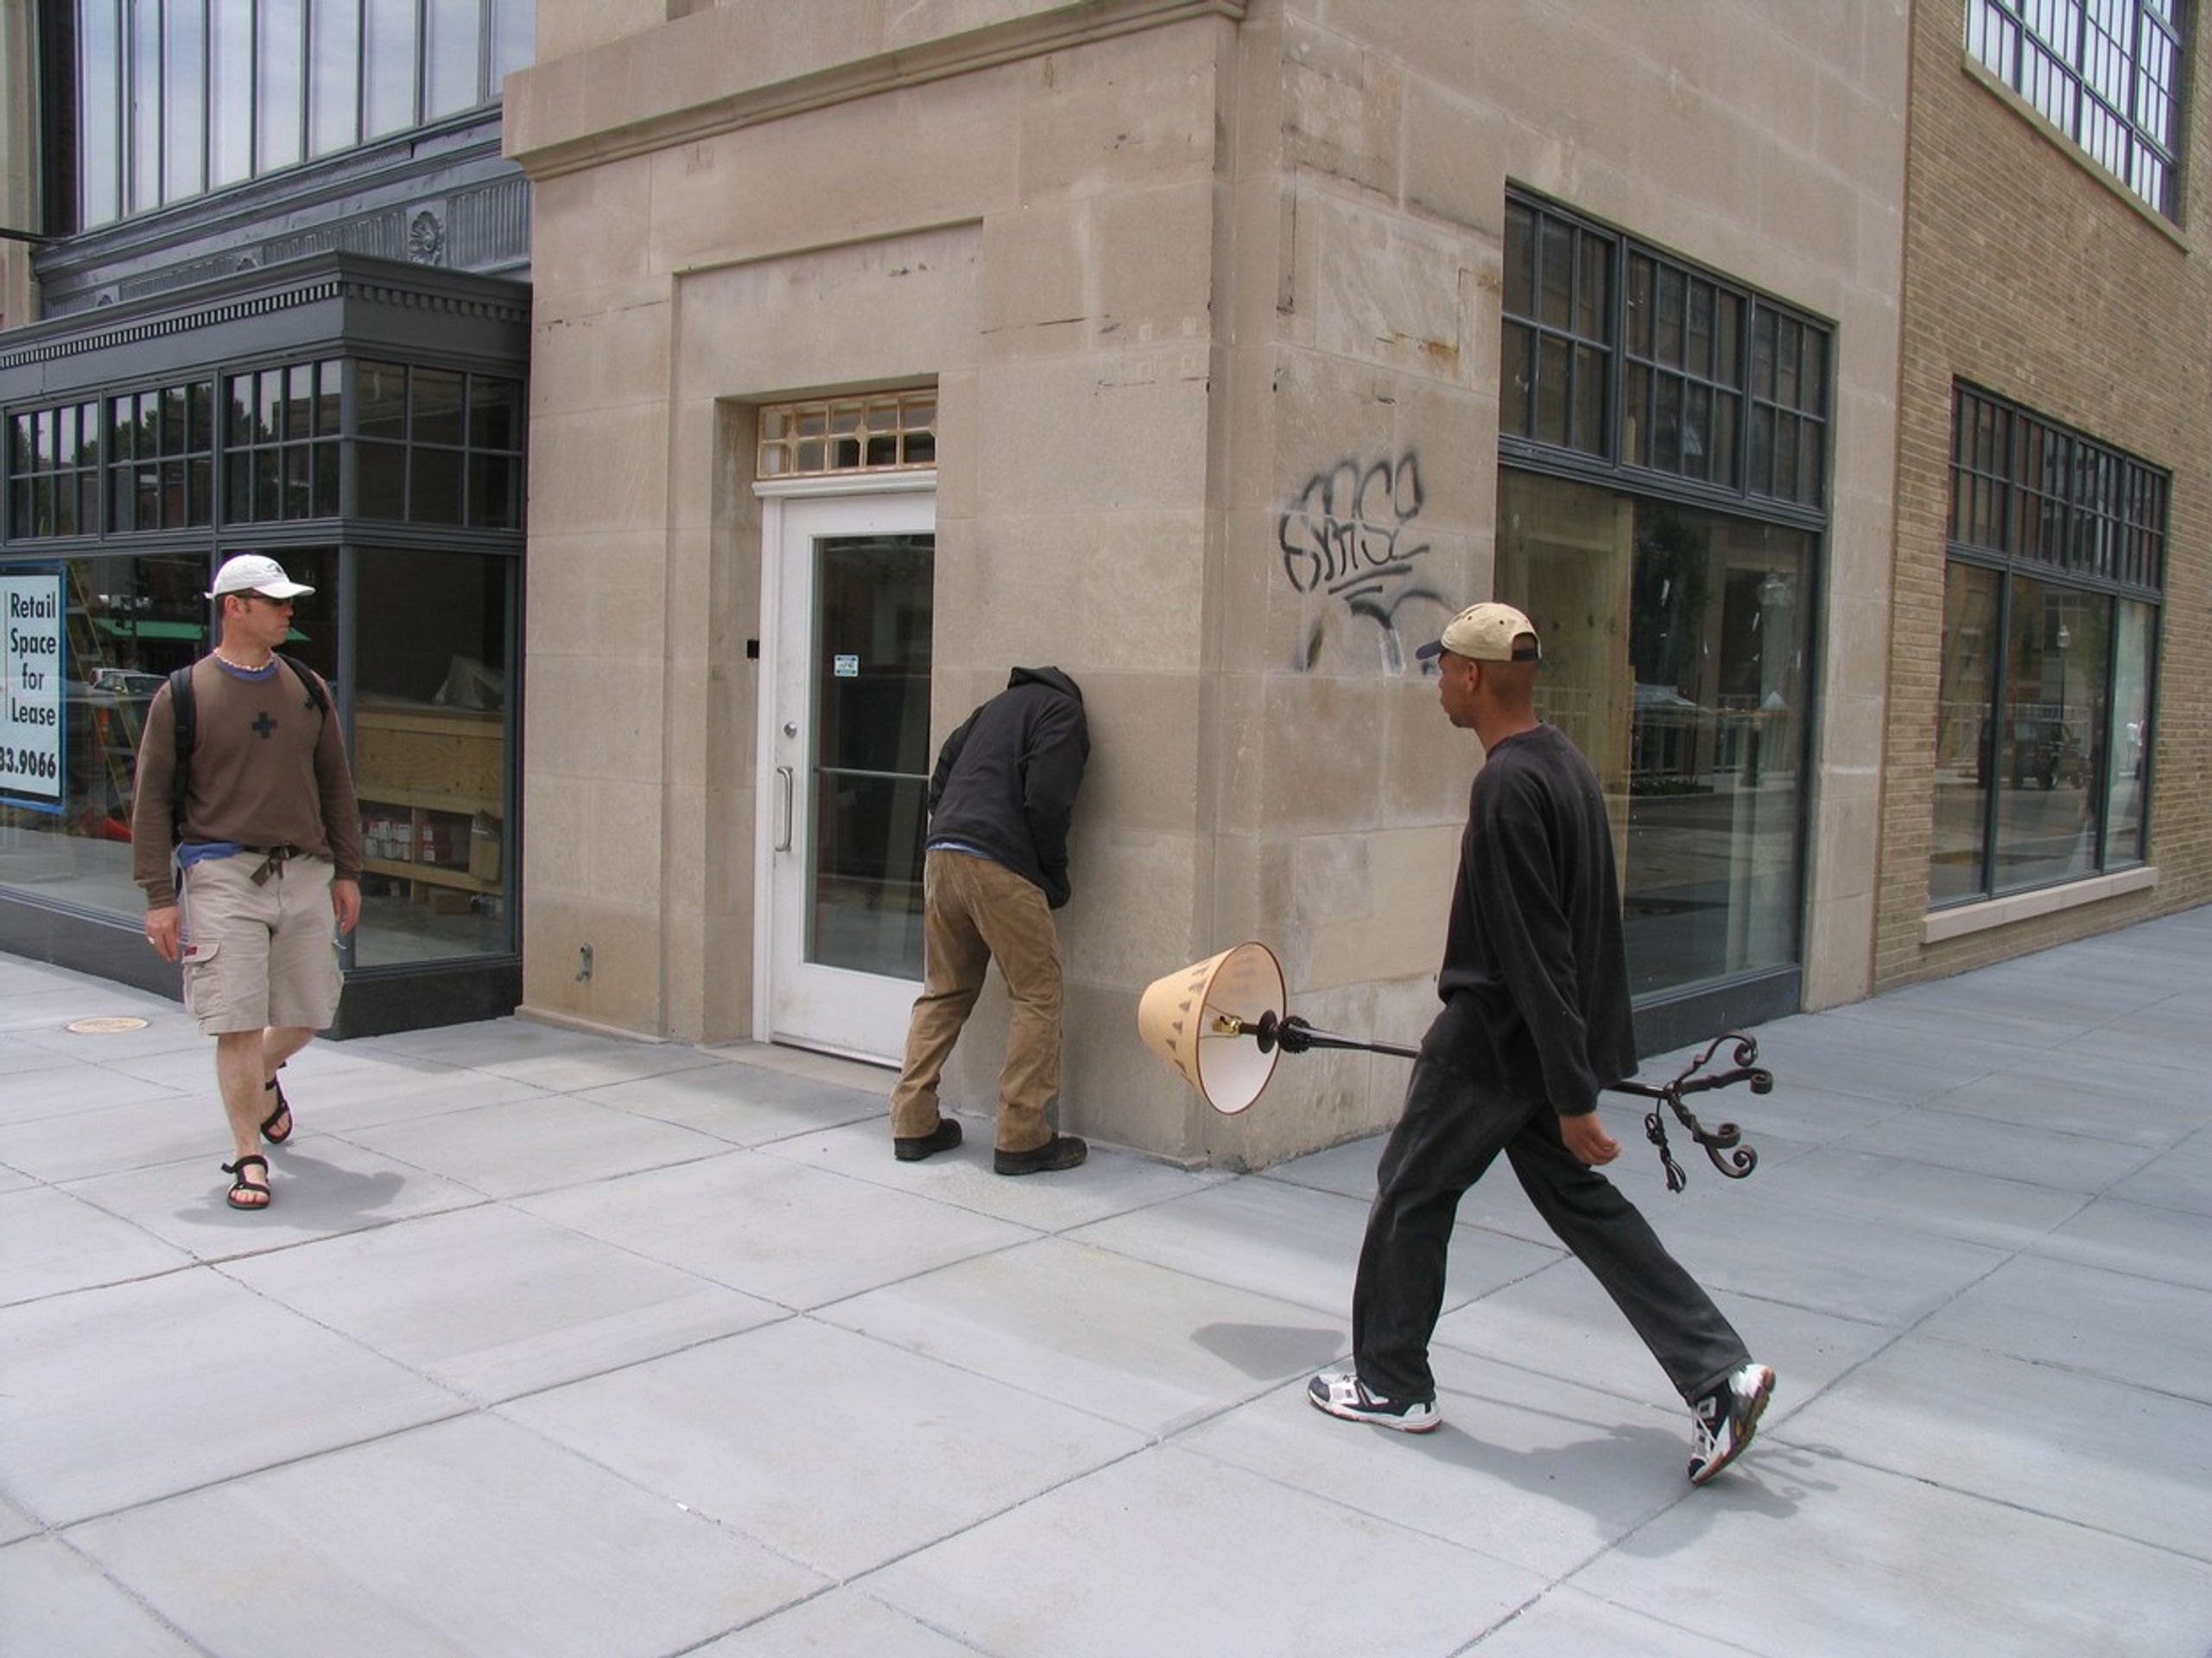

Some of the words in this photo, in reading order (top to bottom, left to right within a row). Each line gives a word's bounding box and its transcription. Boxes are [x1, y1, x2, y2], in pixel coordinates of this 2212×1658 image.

[10, 592, 56, 618] Retail
[10, 627, 56, 659] Space
[22, 662, 45, 690] for
[12, 697, 56, 726] Lease
